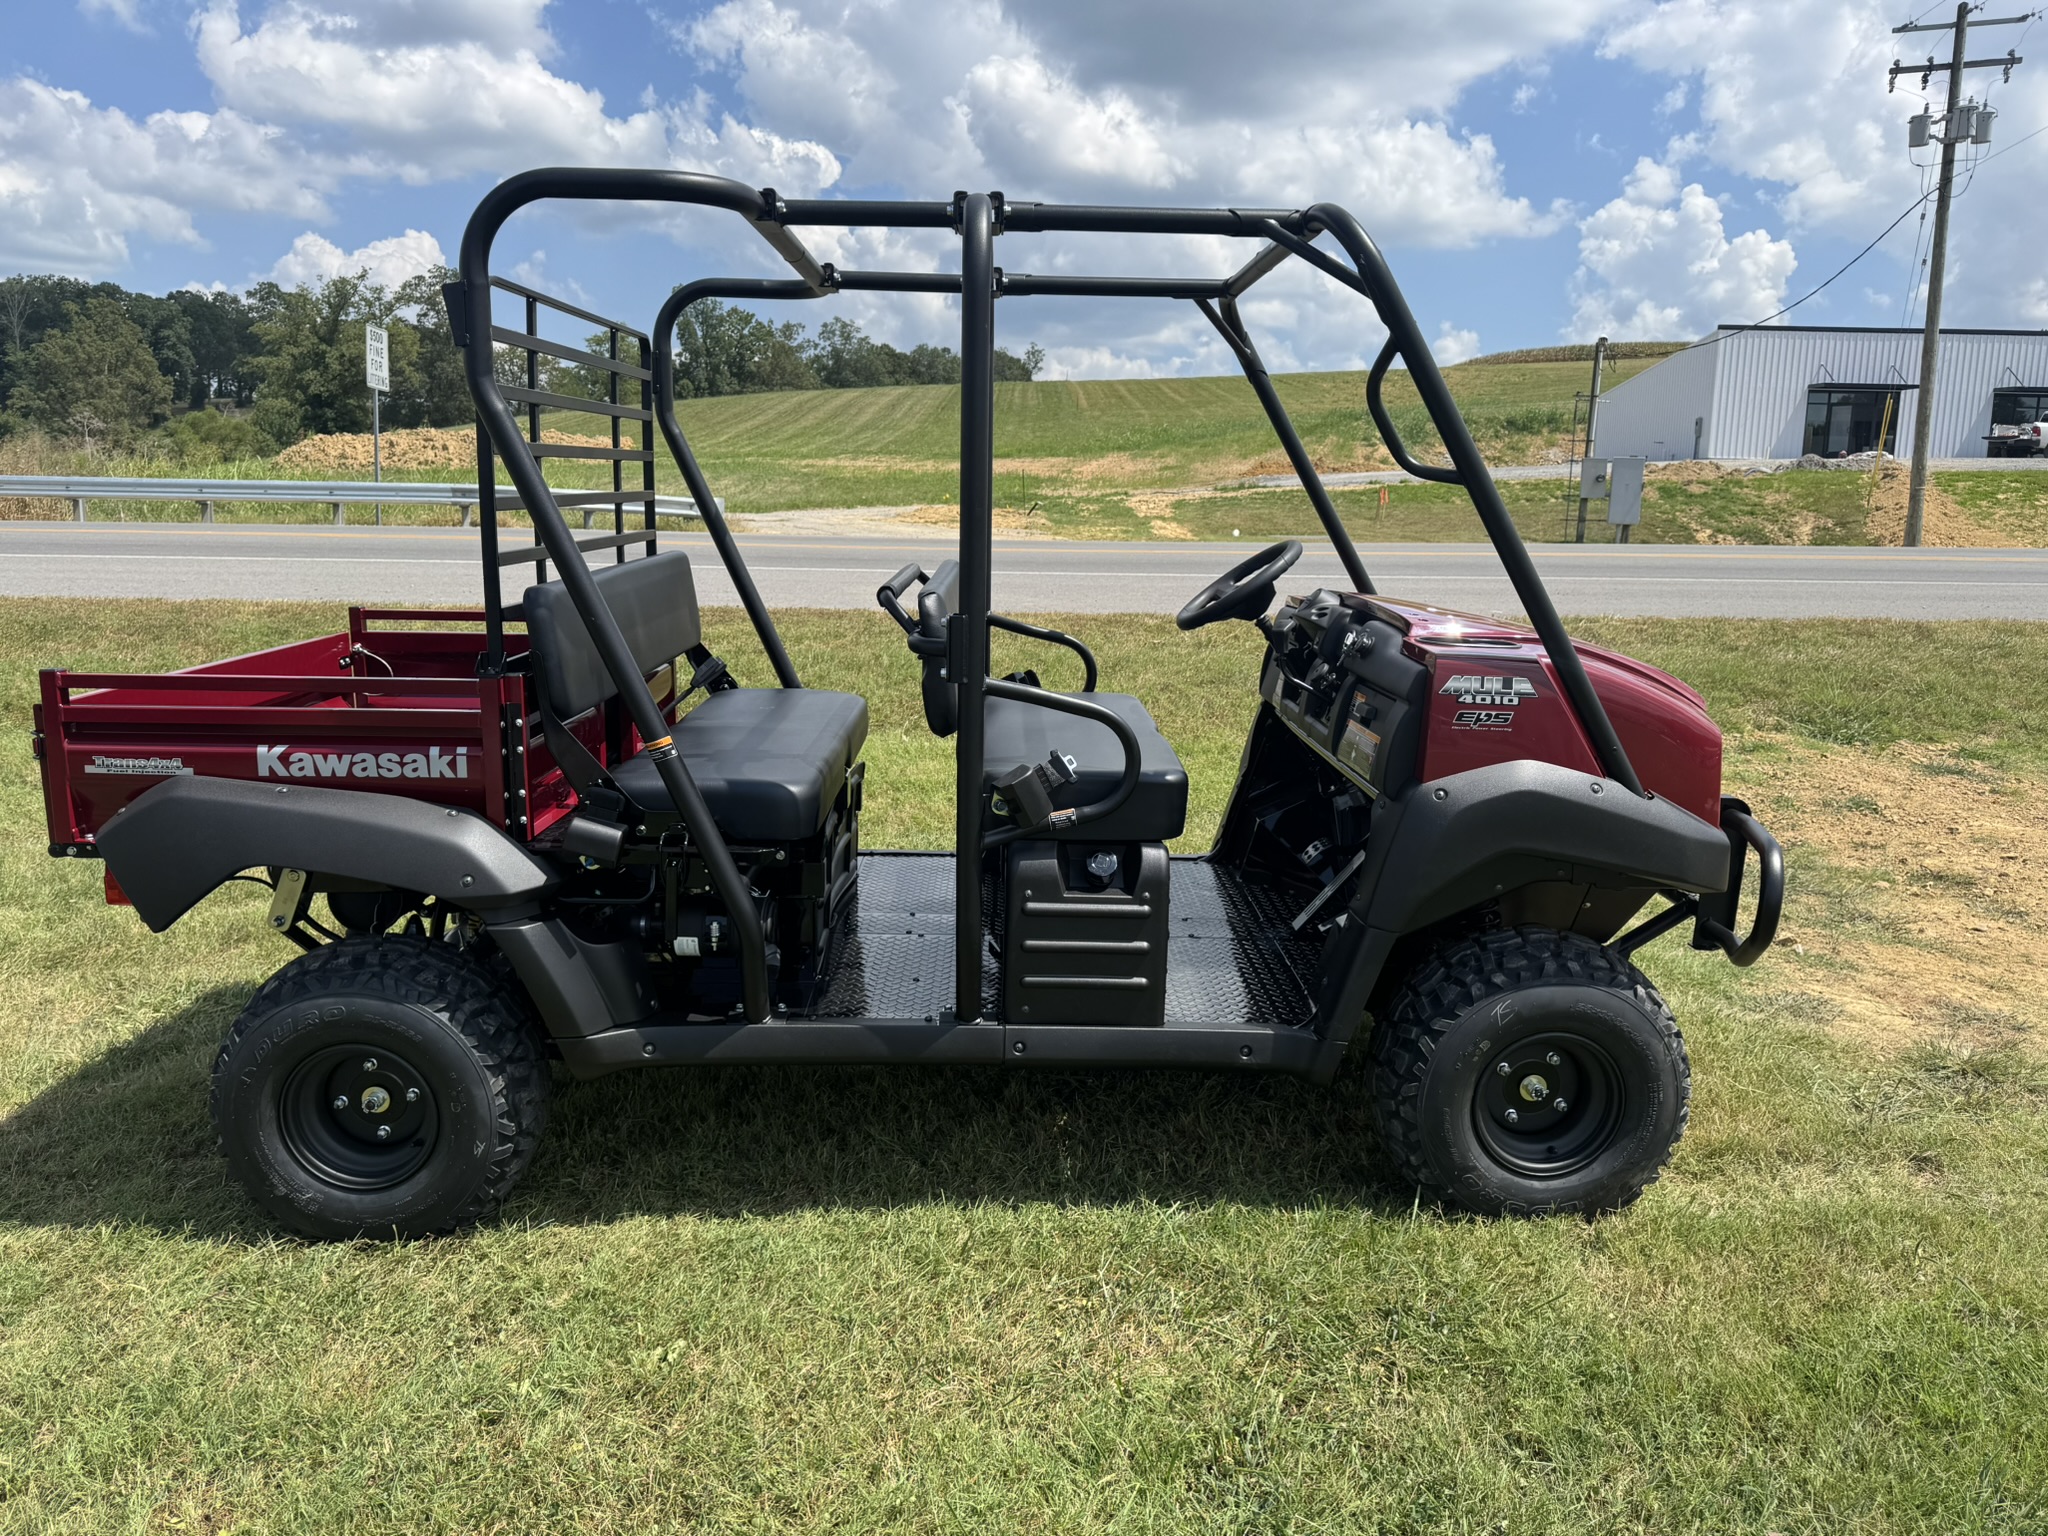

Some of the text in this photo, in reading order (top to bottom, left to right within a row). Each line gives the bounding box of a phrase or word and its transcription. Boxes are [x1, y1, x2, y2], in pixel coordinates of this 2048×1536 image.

[369, 344, 384, 359] FINE
[371, 358, 383, 373] FOR
[1439, 675, 1538, 697] MULE
[1458, 695, 1519, 705] 4010
[92, 756, 183, 770] Trans4x4
[257, 744, 468, 778] Kawasaki
[253, 1005, 346, 1063] DURO
